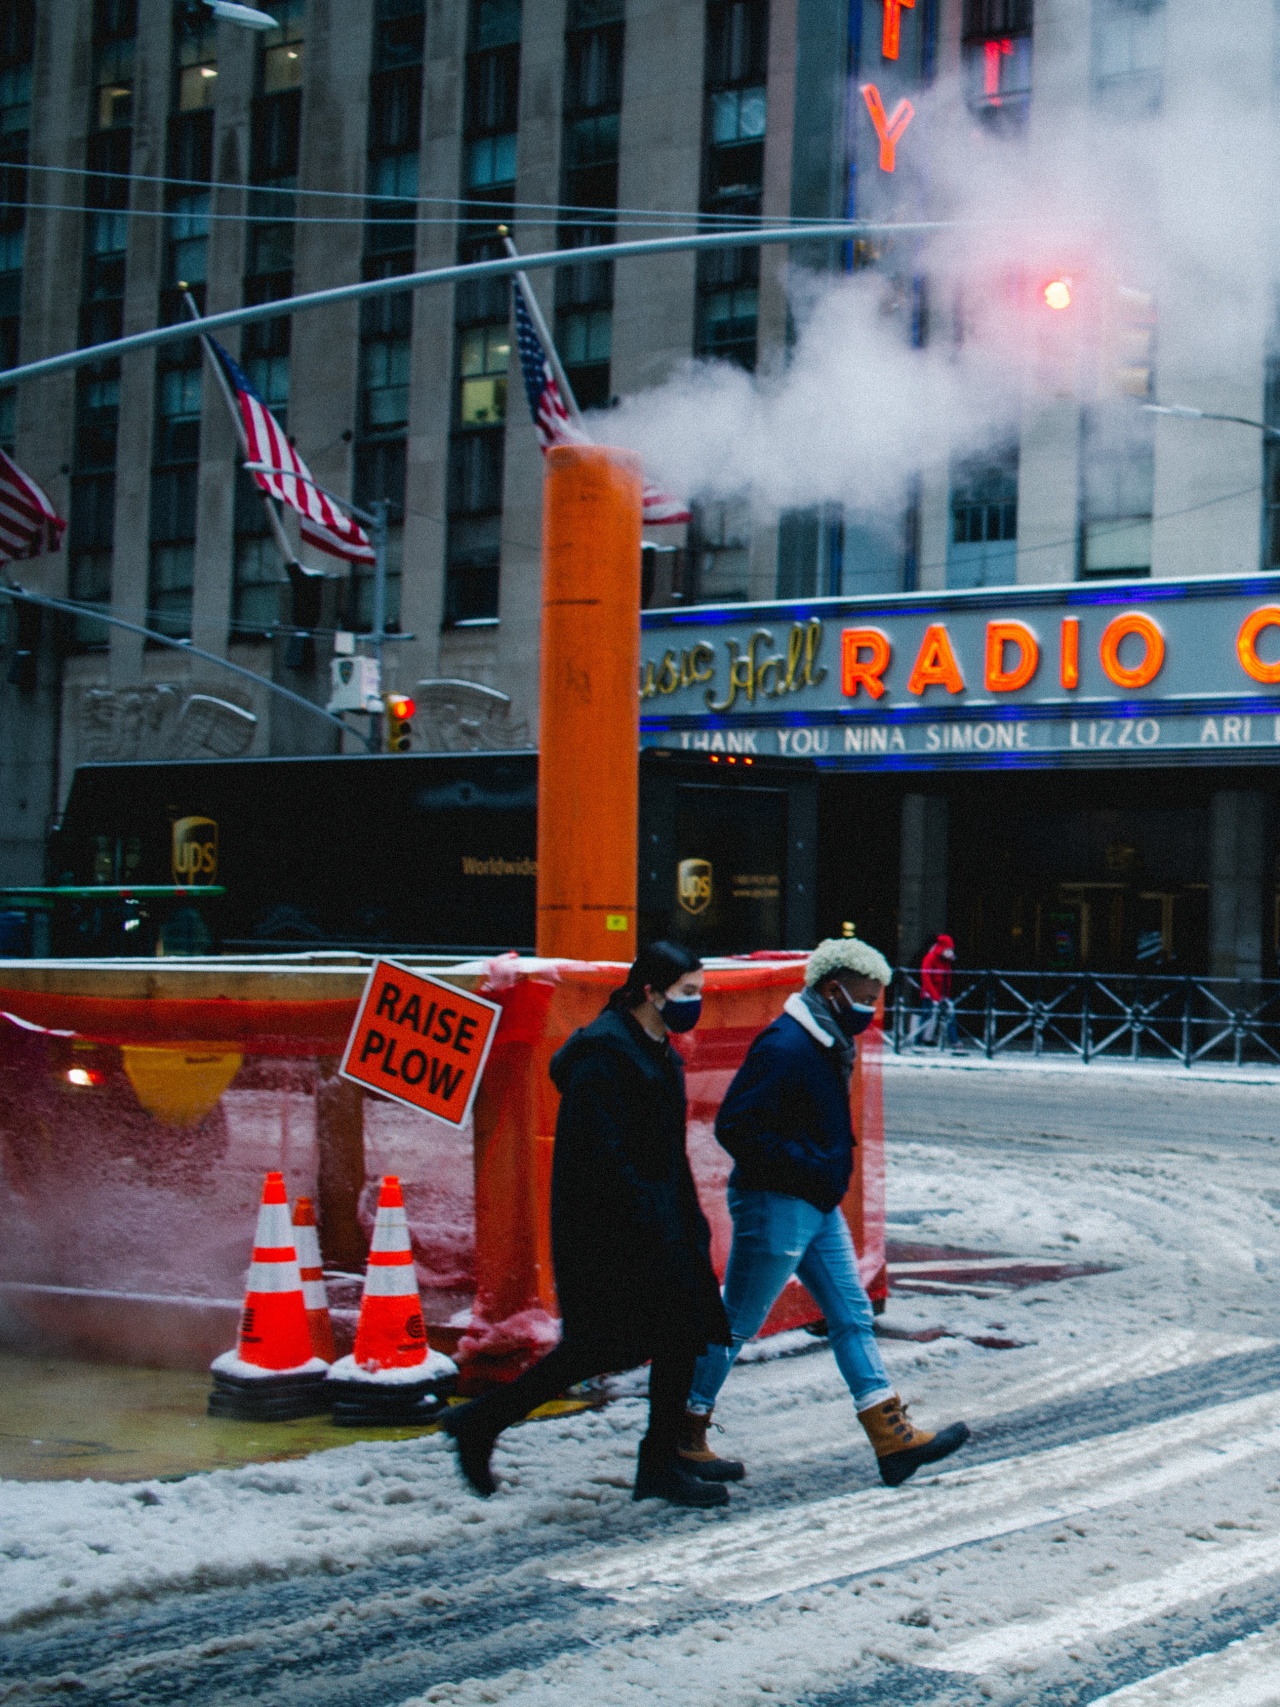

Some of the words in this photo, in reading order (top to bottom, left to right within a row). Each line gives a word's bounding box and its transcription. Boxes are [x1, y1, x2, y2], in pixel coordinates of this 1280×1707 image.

[637, 640, 714, 698] usic
[705, 619, 828, 712] Hall
[841, 611, 1165, 700] RADIO
[680, 731, 758, 755] THANK
[777, 727, 829, 754] YOU
[845, 725, 906, 752] NINA
[925, 722, 1029, 751] SIMONE
[1070, 717, 1161, 749] LIZZO
[1200, 716, 1251, 744] ARI
[375, 982, 478, 1055] RAISE
[360, 1028, 465, 1101] PLOW
